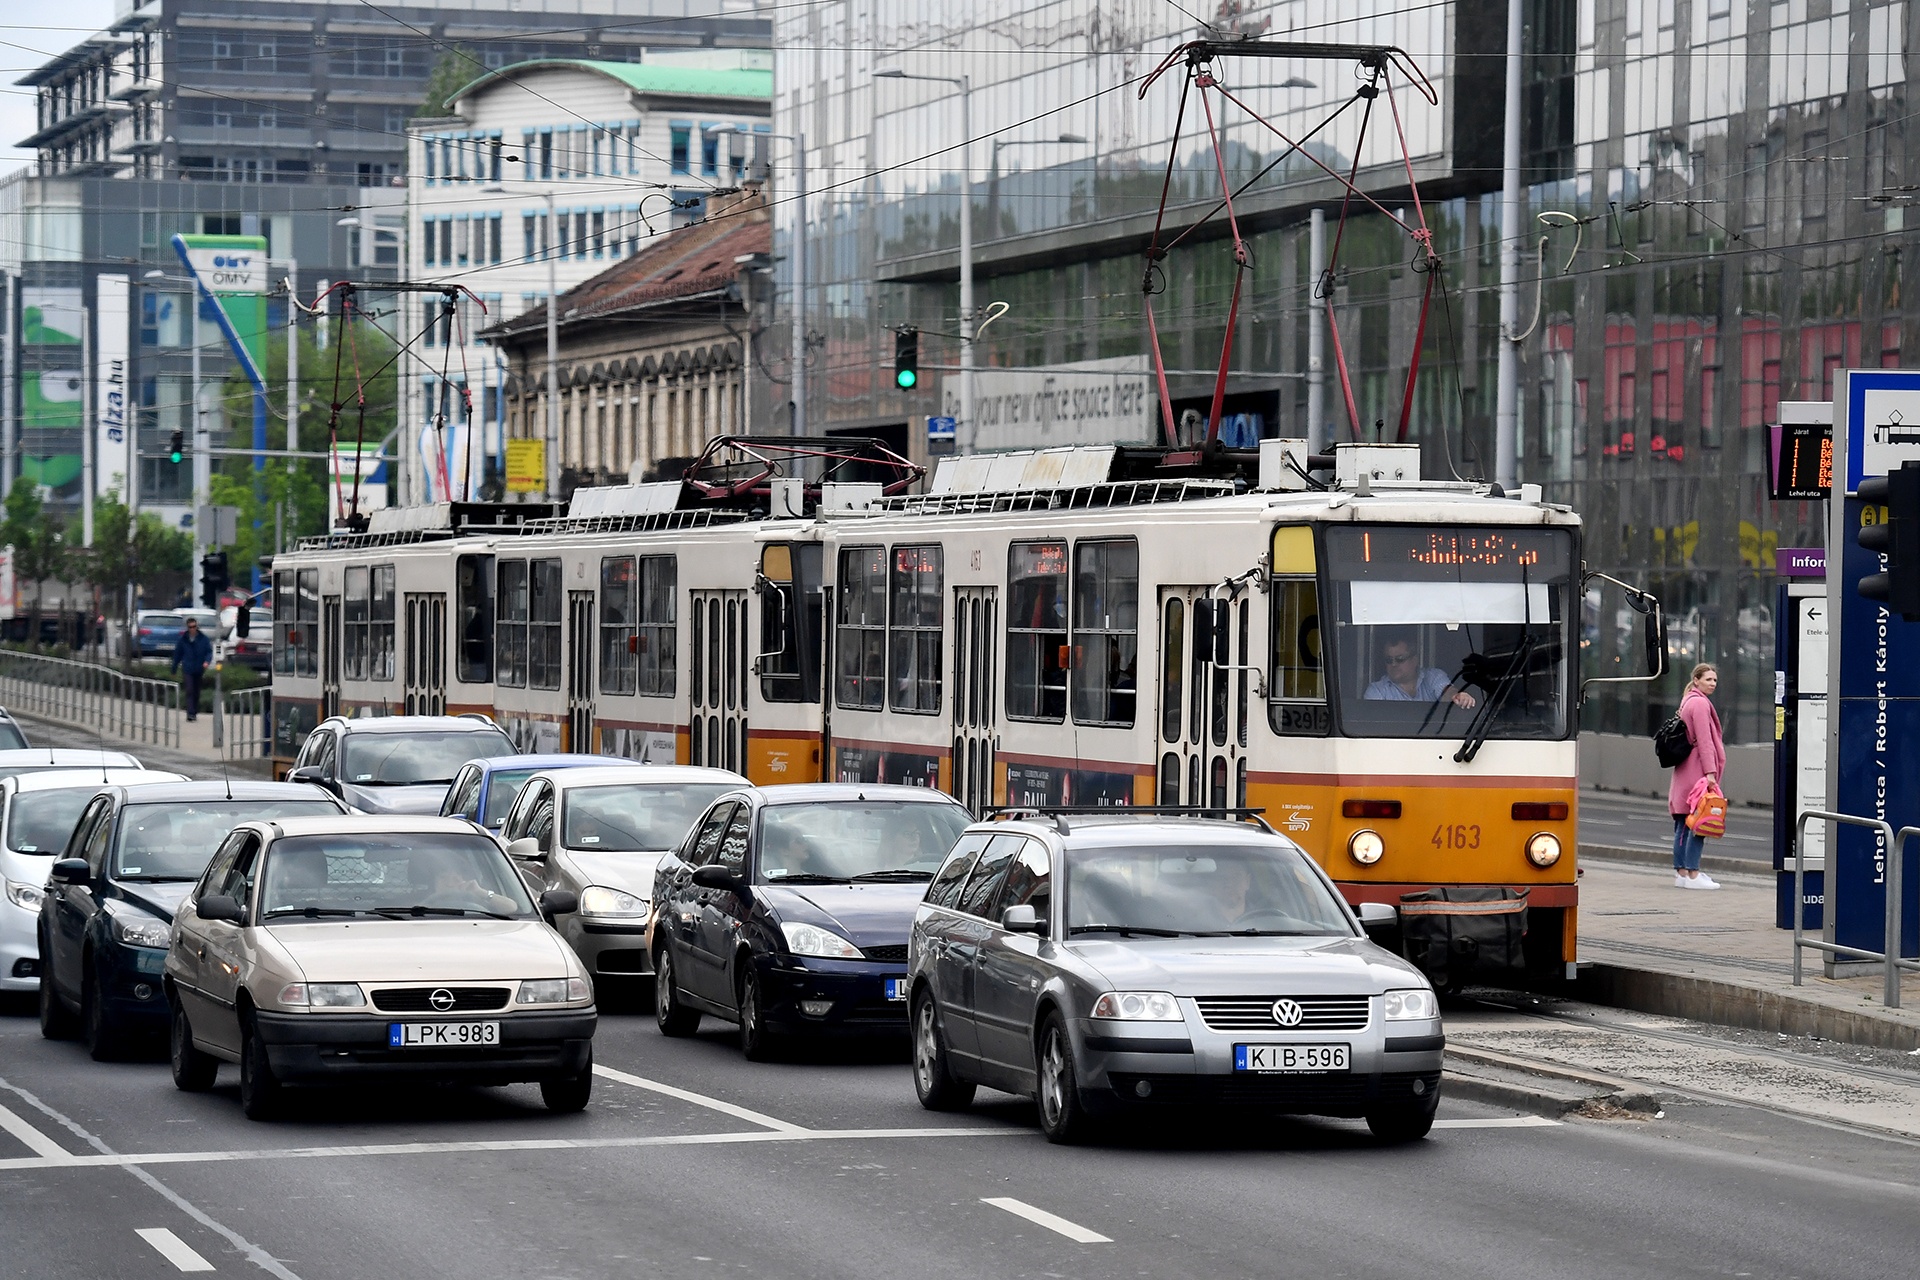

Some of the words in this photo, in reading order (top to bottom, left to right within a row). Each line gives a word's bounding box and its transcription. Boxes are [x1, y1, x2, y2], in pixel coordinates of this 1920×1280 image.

[213, 272, 250, 285] OMV
[103, 359, 124, 444] alza.hu
[1794, 448, 1798, 458] 1
[1795, 438, 1798, 448] 1
[1792, 468, 1796, 477] 1
[1793, 458, 1797, 467] 1
[1791, 477, 1795, 487] 1
[1818, 477, 1833, 488] Ete
[1876, 606, 1890, 672] Károly
[1875, 680, 1887, 752] Róbert
[1875, 775, 1887, 820] utca
[1431, 824, 1481, 850] 4163
[1873, 828, 1885, 884] Lehel
[405, 1024, 495, 1043] LPK-983
[1238, 1059, 1245, 1067] H
[1251, 1047, 1345, 1068] KIB-596
